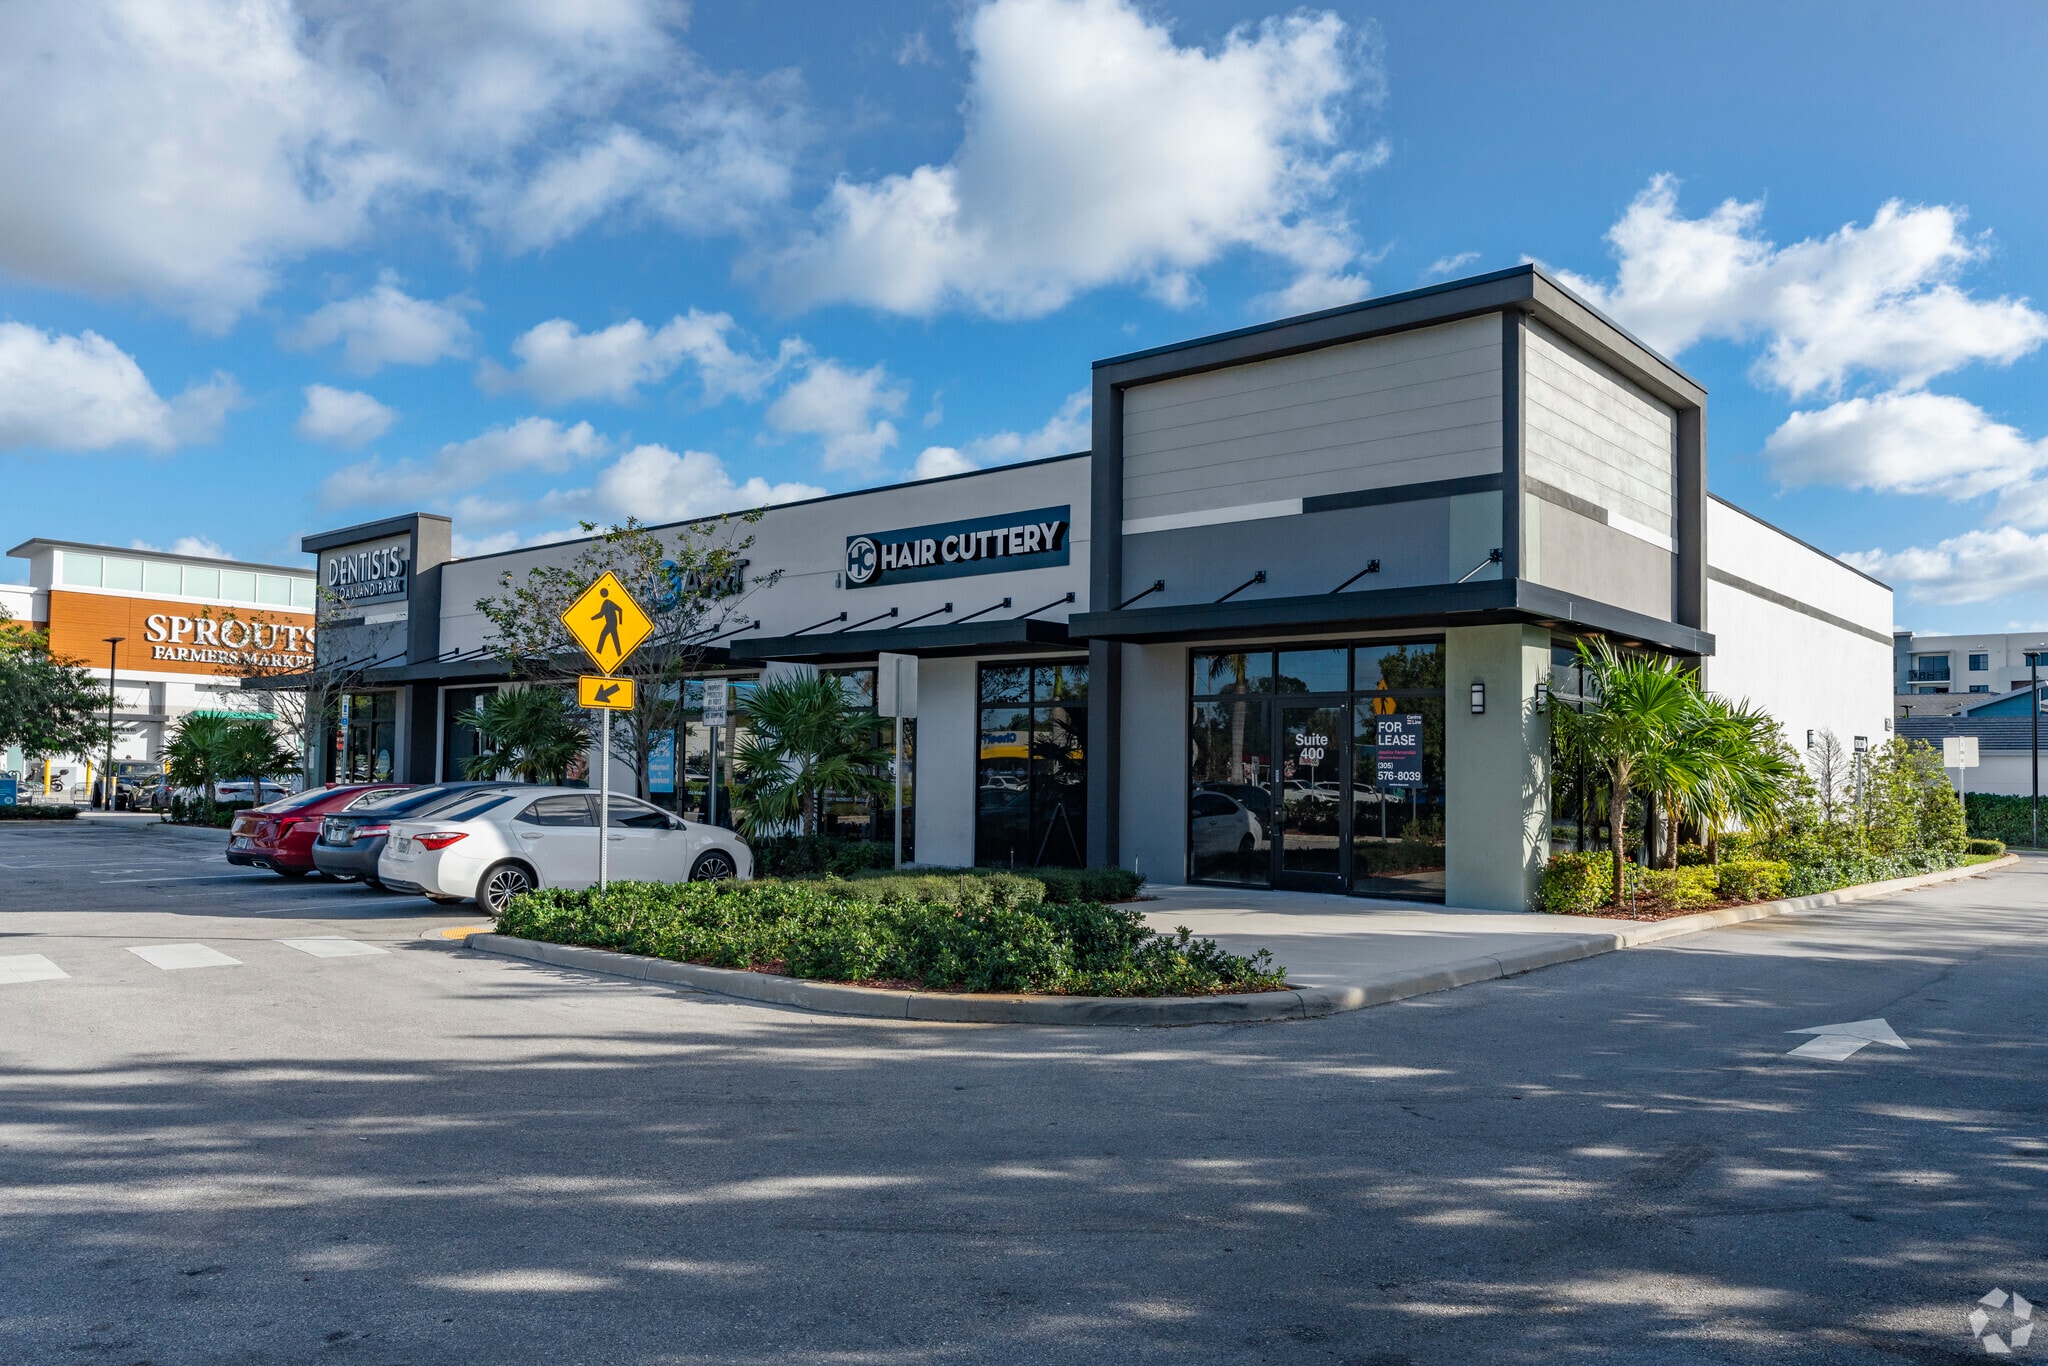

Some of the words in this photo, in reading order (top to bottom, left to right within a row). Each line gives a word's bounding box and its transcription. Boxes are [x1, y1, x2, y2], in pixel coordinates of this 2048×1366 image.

[881, 538, 936, 570] HAIR
[941, 520, 1061, 562] CUTTERY
[328, 546, 401, 586] DENTISTS
[339, 583, 375, 599] OAKLAND
[378, 580, 401, 594] PARK
[154, 645, 239, 665] FARMERS
[244, 651, 315, 669] MARKET
[1378, 721, 1402, 732] FOR
[1295, 733, 1328, 745] Suite
[1378, 734, 1416, 745] LEASE
[1300, 748, 1324, 759] 400
[1377, 762, 1393, 770] (305)
[1377, 771, 1421, 781] 576-8039
